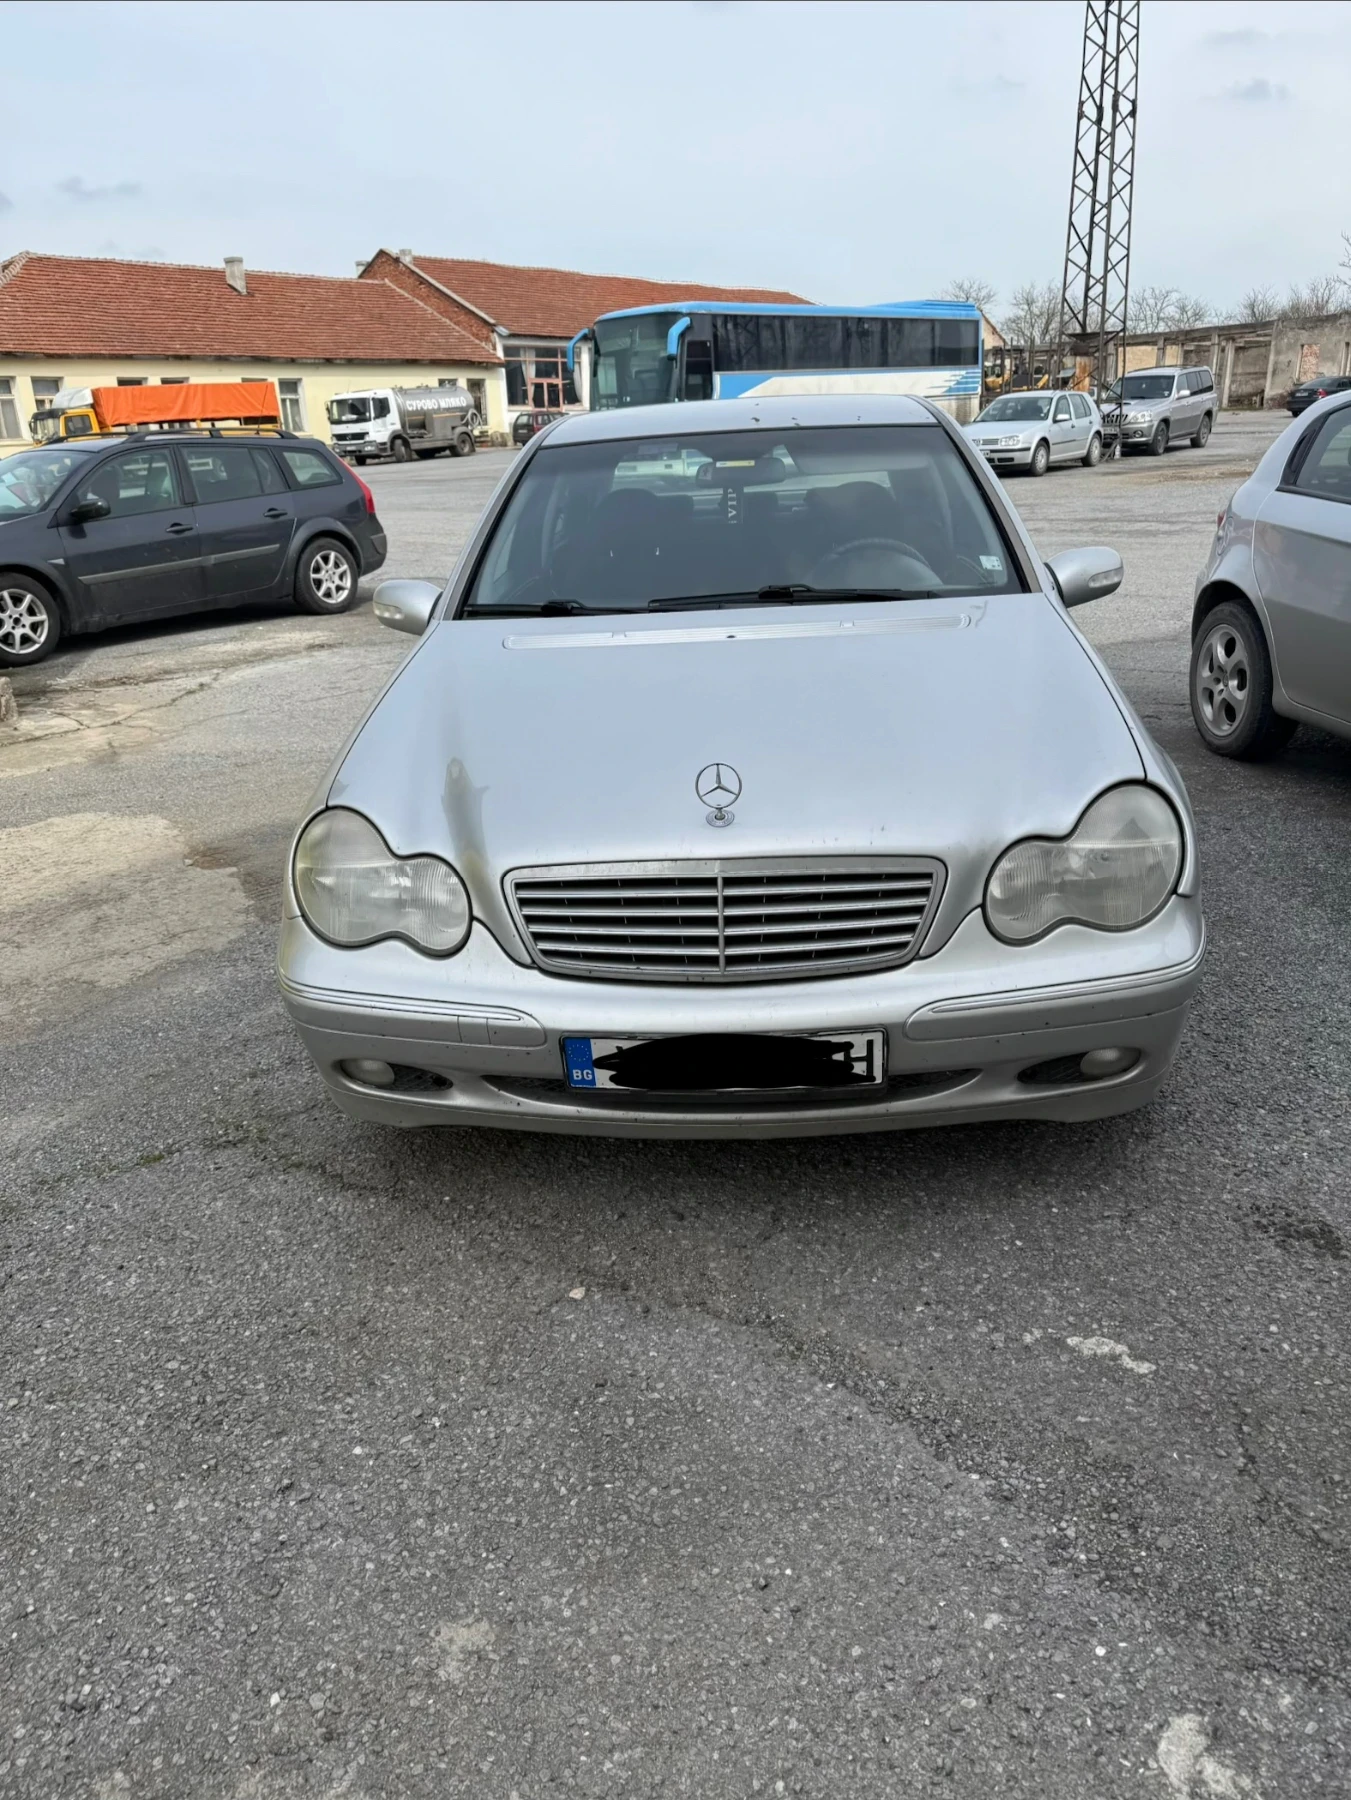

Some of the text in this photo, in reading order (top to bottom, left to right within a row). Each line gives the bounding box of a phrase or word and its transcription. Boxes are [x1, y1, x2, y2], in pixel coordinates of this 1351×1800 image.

[406, 396, 467, 411] СУРОВО МЛЯКО
[727, 488, 737, 518] VIP
[572, 1069, 593, 1081] BG
